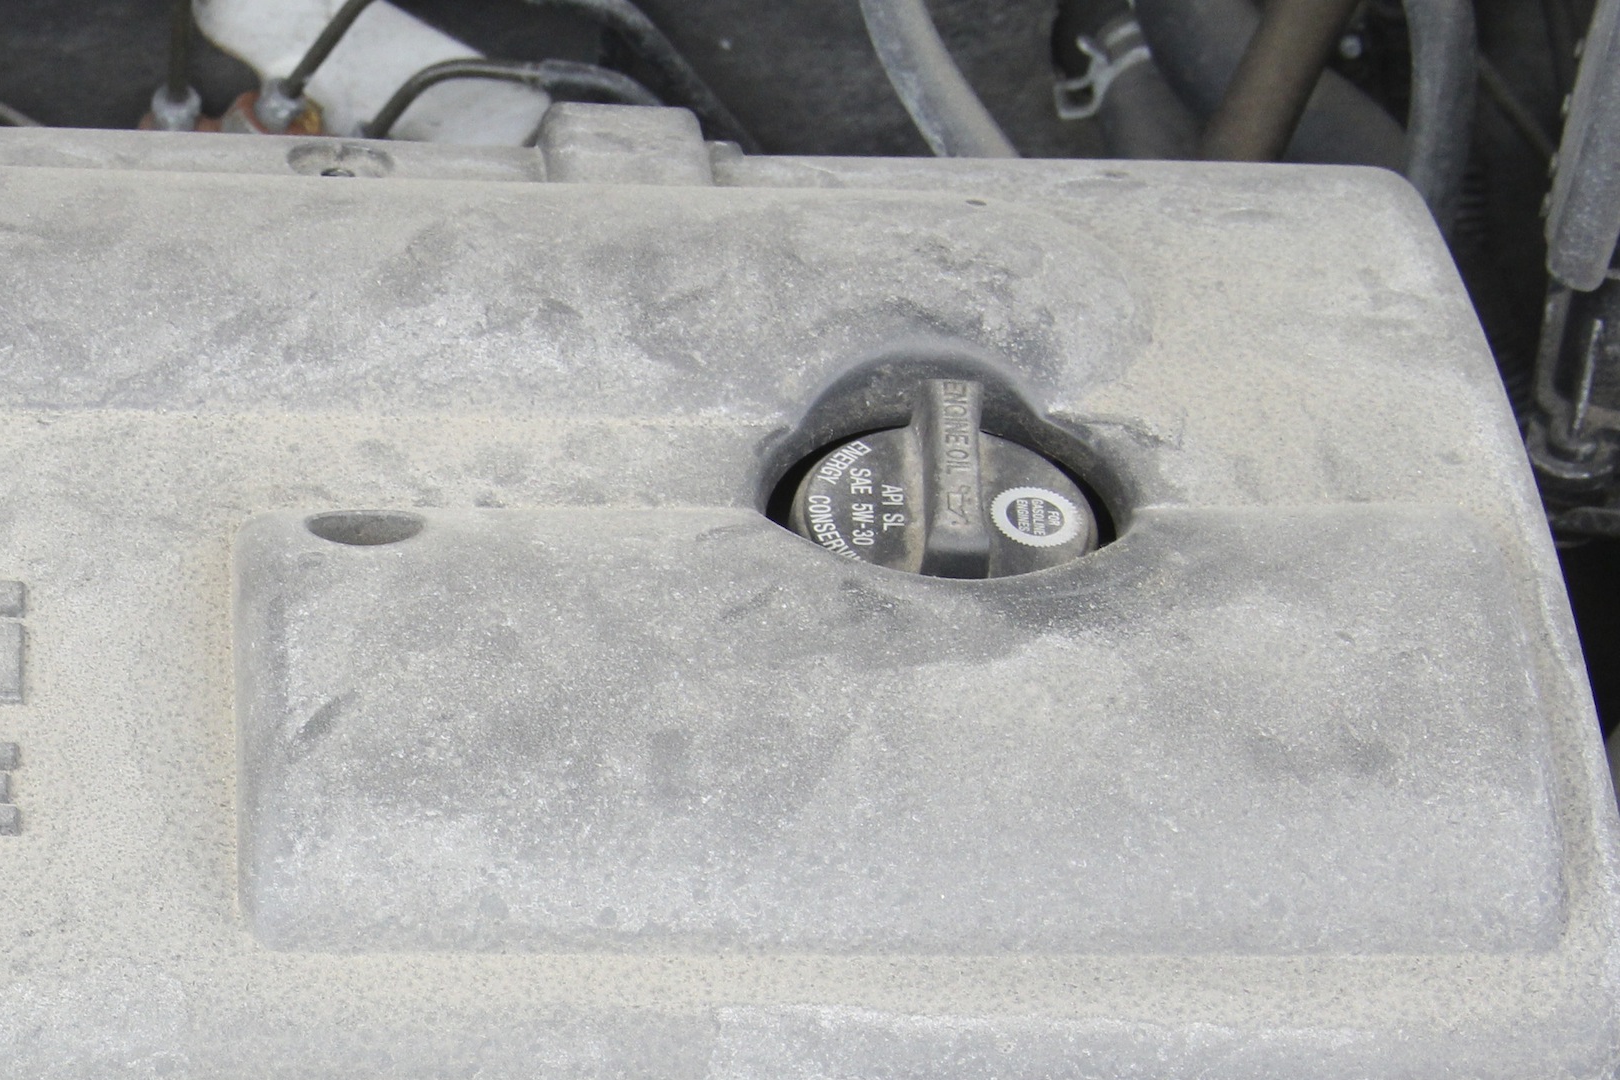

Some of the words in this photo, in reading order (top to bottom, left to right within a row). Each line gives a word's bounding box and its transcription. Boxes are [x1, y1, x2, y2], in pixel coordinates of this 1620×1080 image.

[817, 440, 872, 485] ENERGY
[946, 449, 971, 475] OIL
[849, 468, 873, 494] SAE
[881, 484, 904, 506] API
[851, 503, 875, 546] 5W-30
[883, 513, 905, 531] SL
[1016, 499, 1031, 532] ENGINES
[1031, 498, 1046, 536] GASOLINE
[1047, 510, 1061, 527] FOR
